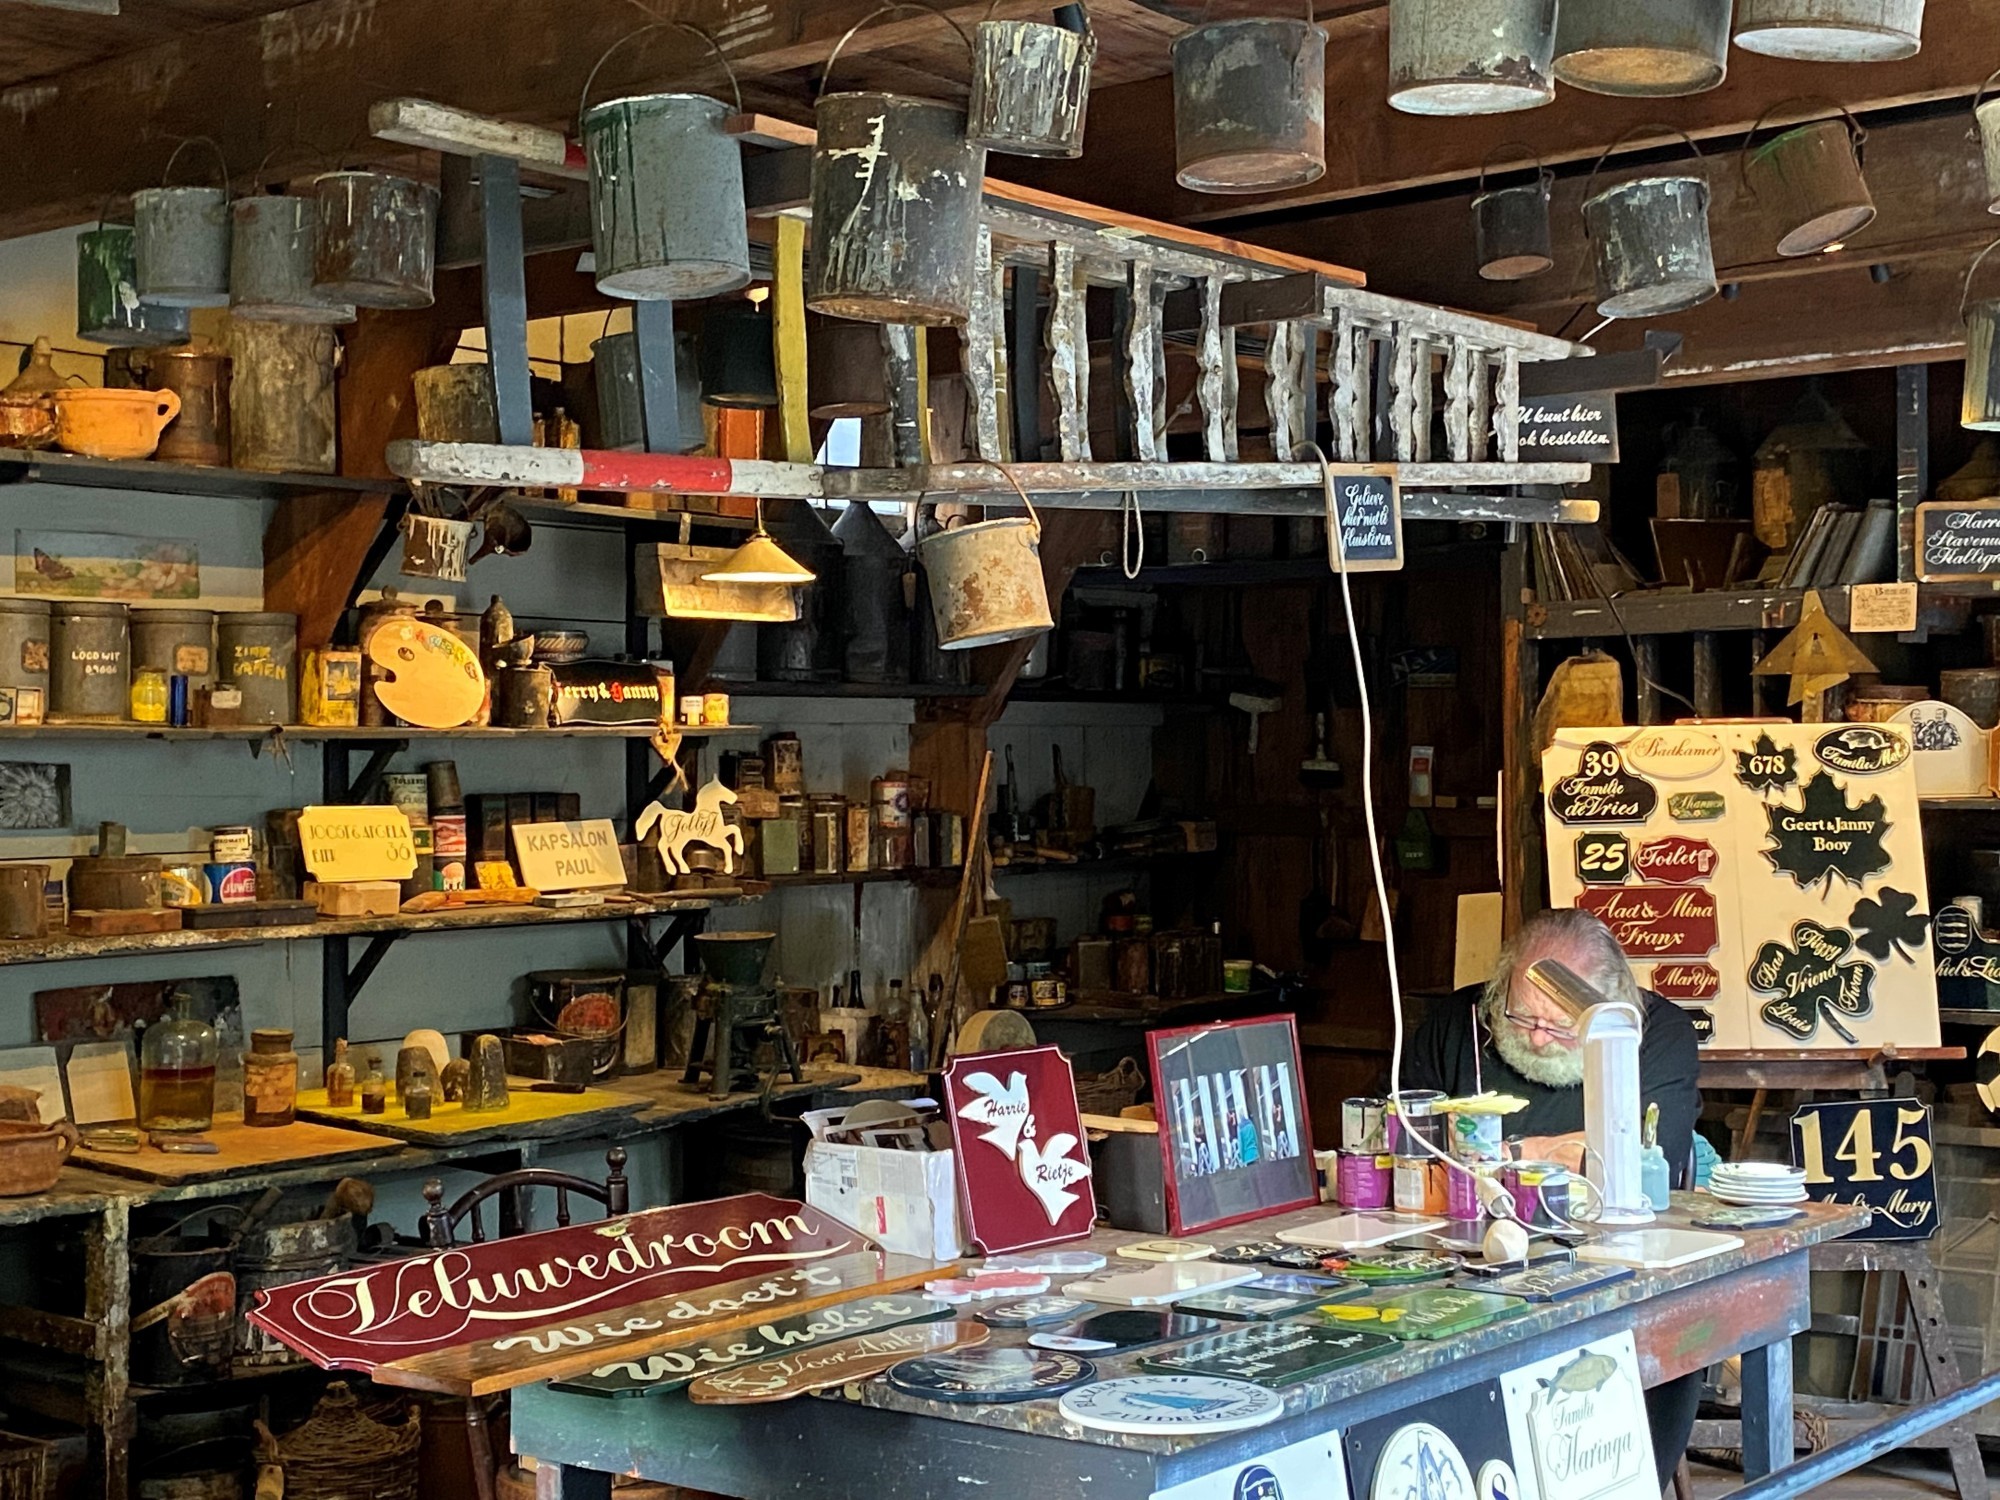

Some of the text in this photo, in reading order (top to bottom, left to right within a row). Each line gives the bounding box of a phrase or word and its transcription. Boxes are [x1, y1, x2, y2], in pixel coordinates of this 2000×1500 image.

[1533, 406, 1571, 423] kunt
[1571, 403, 1602, 422] hier
[1518, 428, 1610, 446] ok bestellen.
[1634, 737, 1721, 758] Badkamer
[1822, 746, 1874, 770] Familie
[1584, 751, 1619, 777] 39
[1749, 755, 1786, 775] 678
[1561, 776, 1625, 796] Familie
[1781, 817, 1825, 831] Geert
[1834, 817, 1876, 834] Janny
[386, 842, 411, 861] 36
[526, 831, 608, 852] KAPSALON
[1637, 841, 1699, 868] Toilet
[1813, 837, 1852, 854] Booy
[555, 858, 596, 877] PAUL
[1580, 842, 1626, 871] 25
[1593, 892, 1714, 919] Aad & Mina
[1612, 919, 1684, 951] Franx
[1757, 950, 1784, 988] Bas
[1935, 957, 1968, 977] hiel
[1785, 963, 1838, 998] Vriend
[1839, 965, 1864, 1011] Twan
[1767, 1002, 1812, 1032] Louis
[984, 1098, 1026, 1118] Harrie
[1023, 1114, 1036, 1138] &
[1793, 1107, 1933, 1184] 145
[1036, 1163, 1073, 1184] Rietje
[1871, 1188, 1932, 1229] Mary
[293, 1212, 820, 1345] Veluwedroom
[494, 1314, 664, 1353] Wie
[592, 1335, 765, 1381] Wie
[758, 1350, 846, 1377] Voor
[1552, 1392, 1595, 1431] Familie
[1546, 1425, 1632, 1482] Haringa
